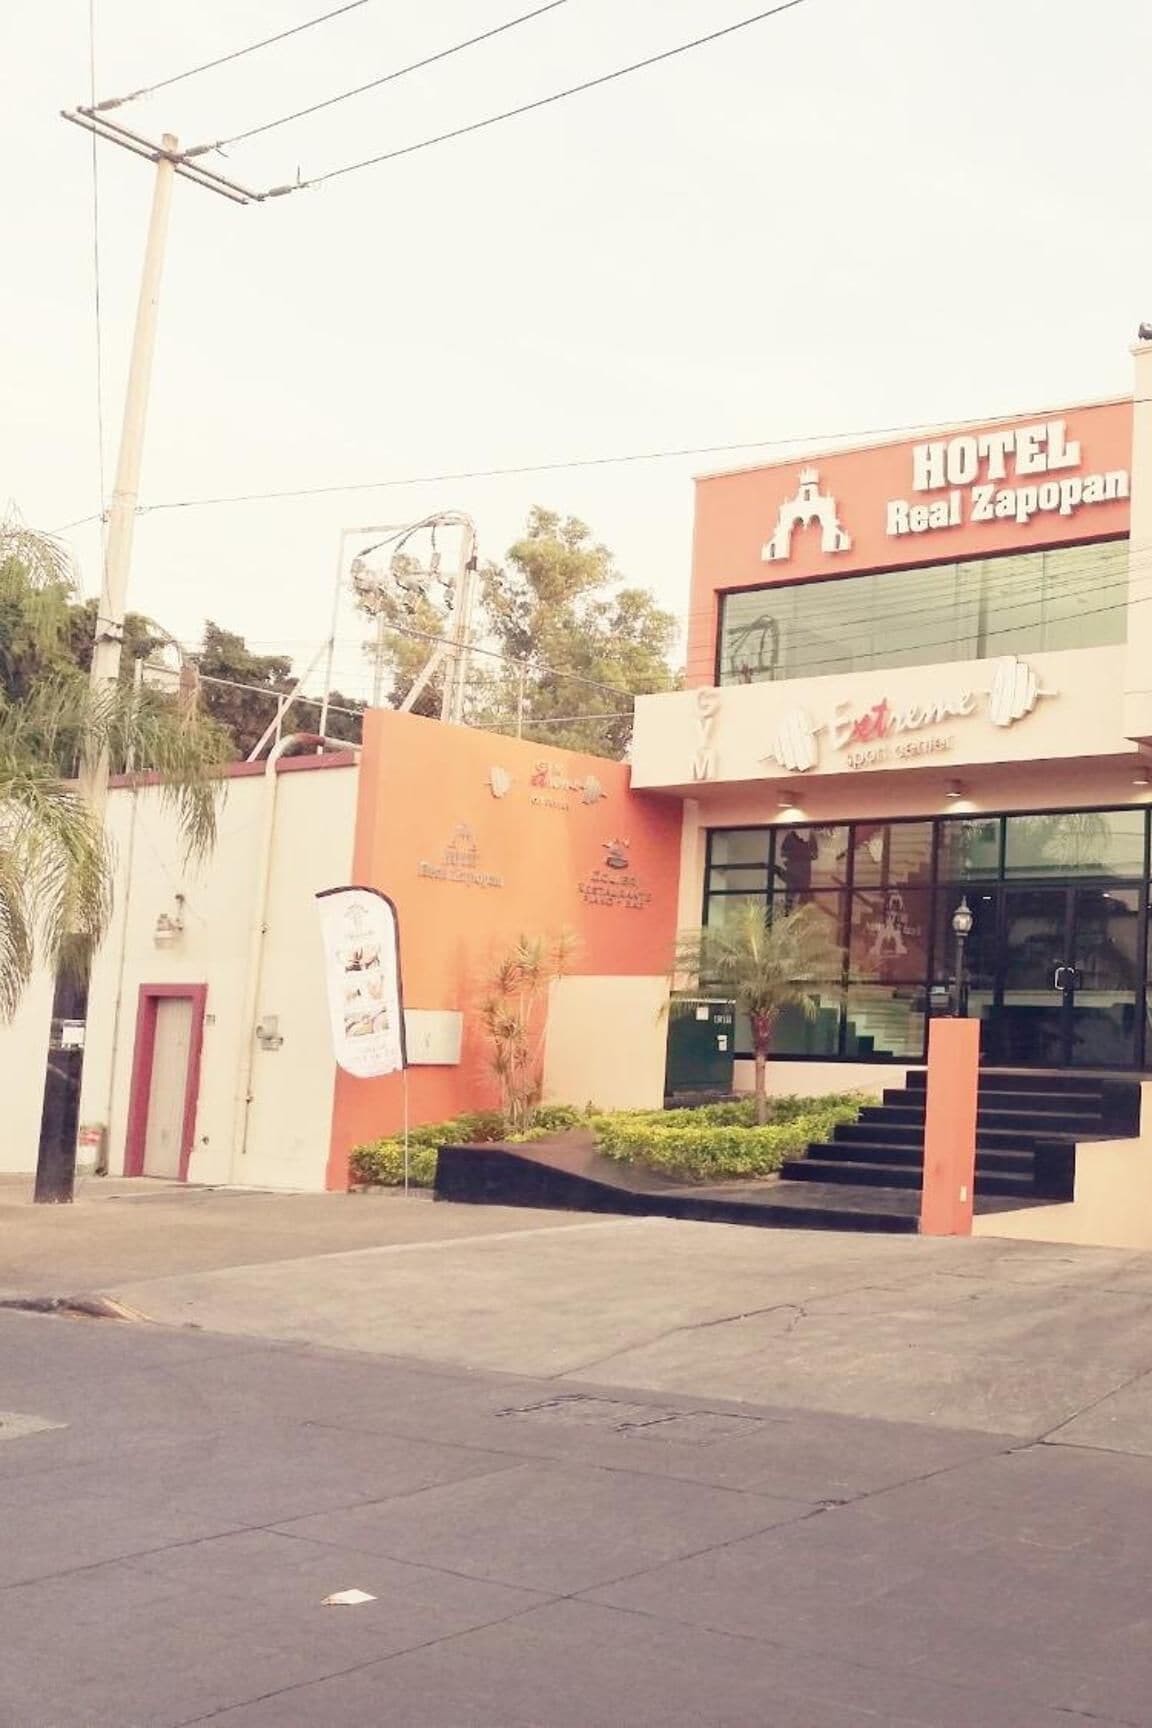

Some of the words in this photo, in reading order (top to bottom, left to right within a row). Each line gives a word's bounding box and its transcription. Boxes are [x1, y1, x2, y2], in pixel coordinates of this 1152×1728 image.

[912, 419, 1081, 491] HOTEL
[886, 490, 962, 535] Real
[970, 469, 1131, 524] Zapopan
[689, 689, 721, 780] GYM
